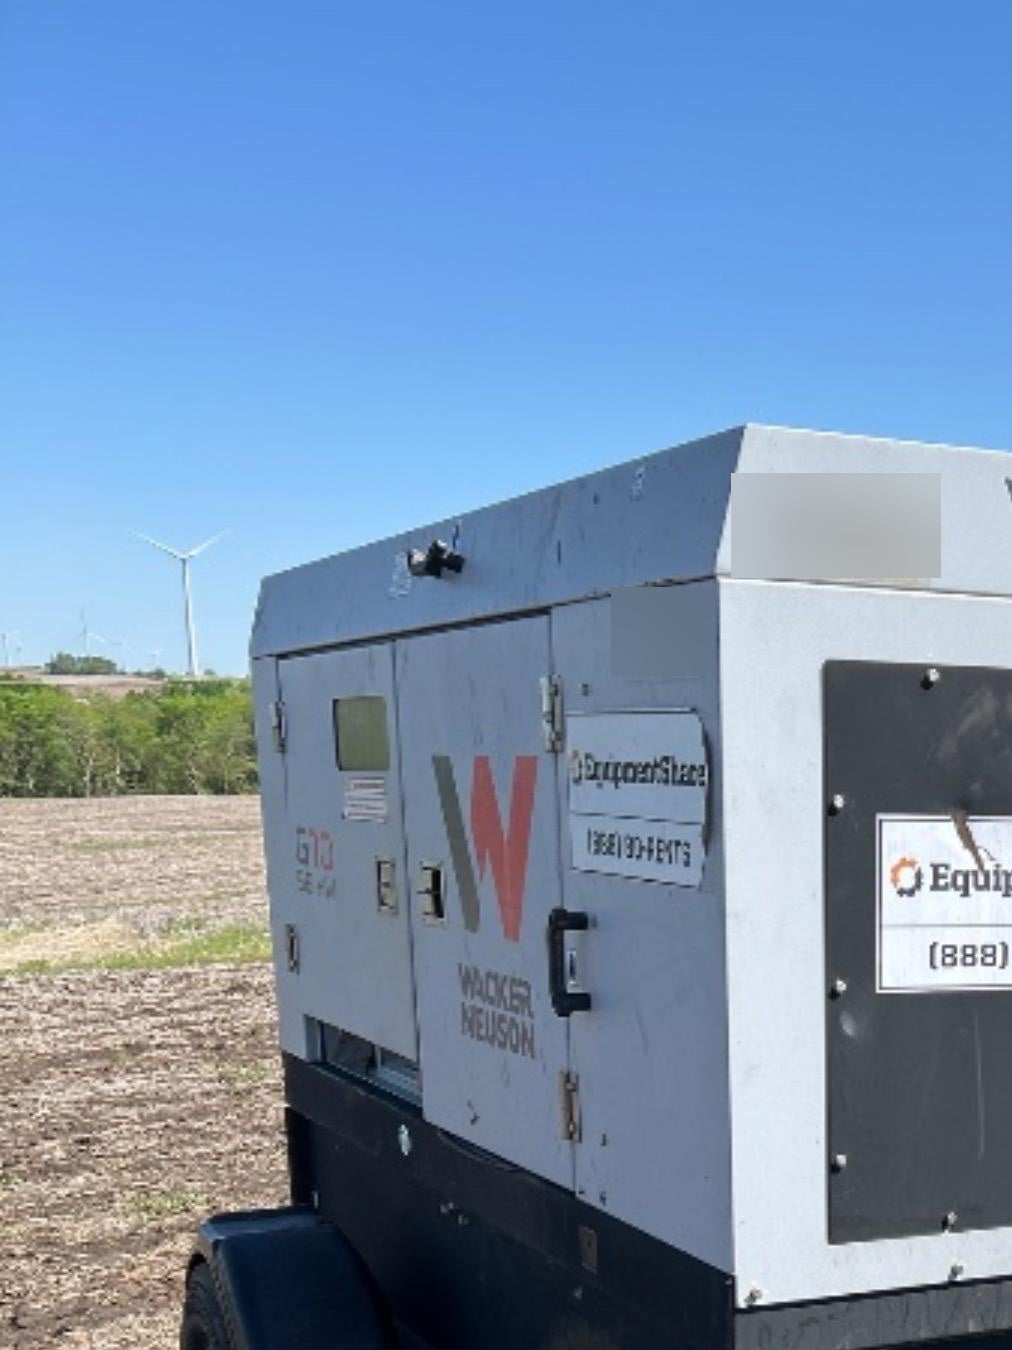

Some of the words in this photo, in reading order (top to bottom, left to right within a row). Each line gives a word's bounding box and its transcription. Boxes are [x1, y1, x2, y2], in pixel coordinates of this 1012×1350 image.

[584, 752, 706, 790] EquipmentShare
[928, 941, 1009, 970] (888)
[458, 962, 534, 1020] WACKER
[461, 1001, 536, 1060] NEUSON
